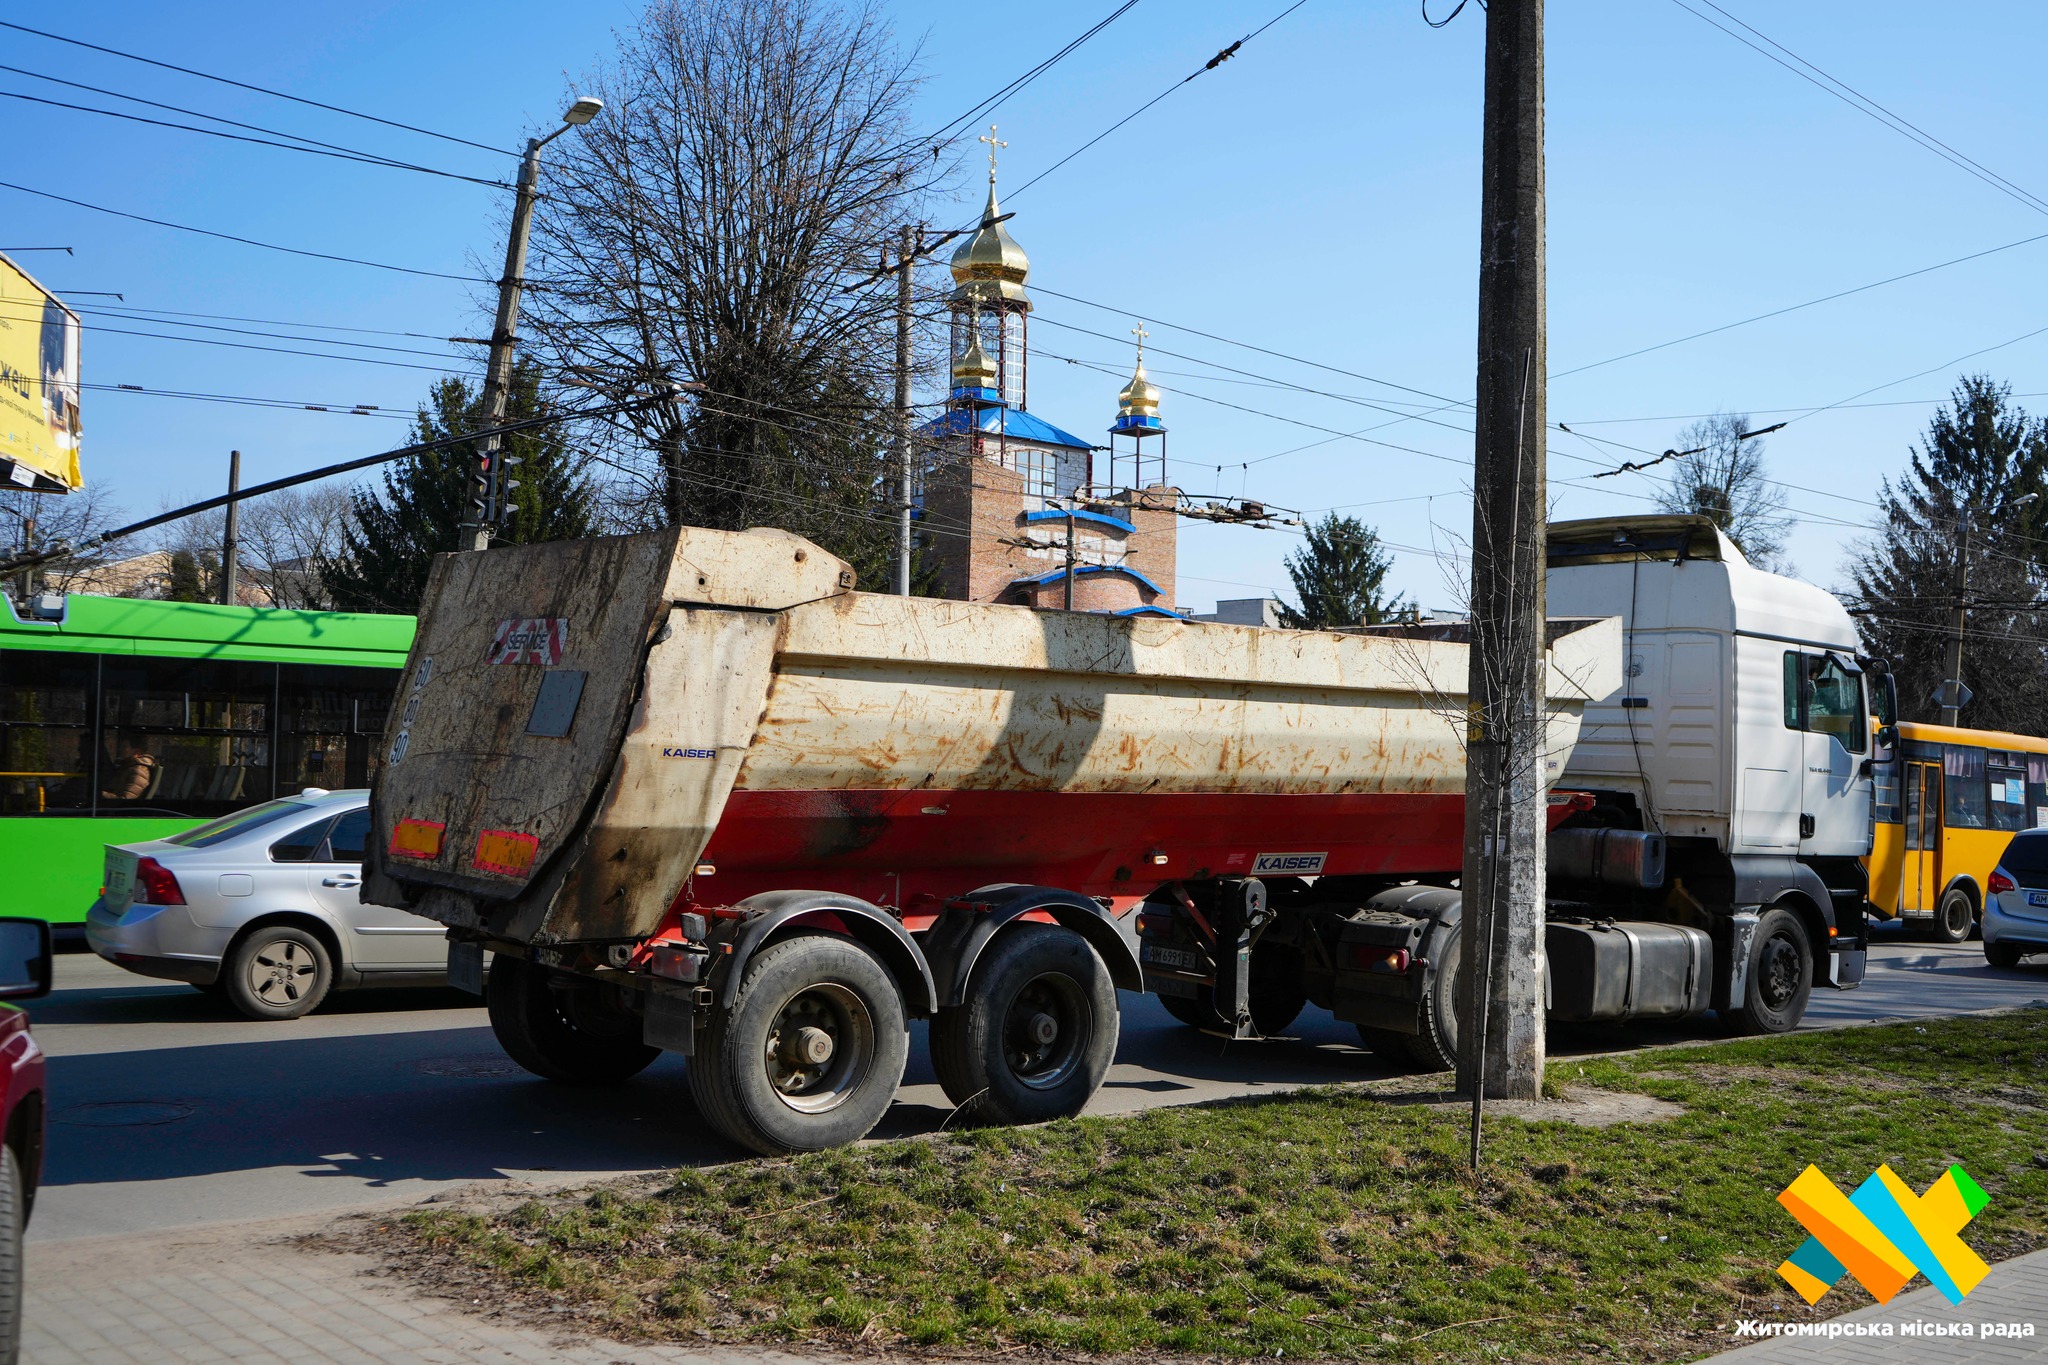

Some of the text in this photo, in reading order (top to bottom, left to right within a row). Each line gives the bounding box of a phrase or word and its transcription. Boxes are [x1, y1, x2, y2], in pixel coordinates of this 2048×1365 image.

[508, 632, 548, 650] SERVICE
[414, 659, 432, 687] 60
[403, 699, 418, 723] 80
[390, 734, 408, 763] 90
[662, 748, 716, 759] KAISER
[1257, 857, 1321, 870] KAISER
[2035, 895, 2047, 904] AM
